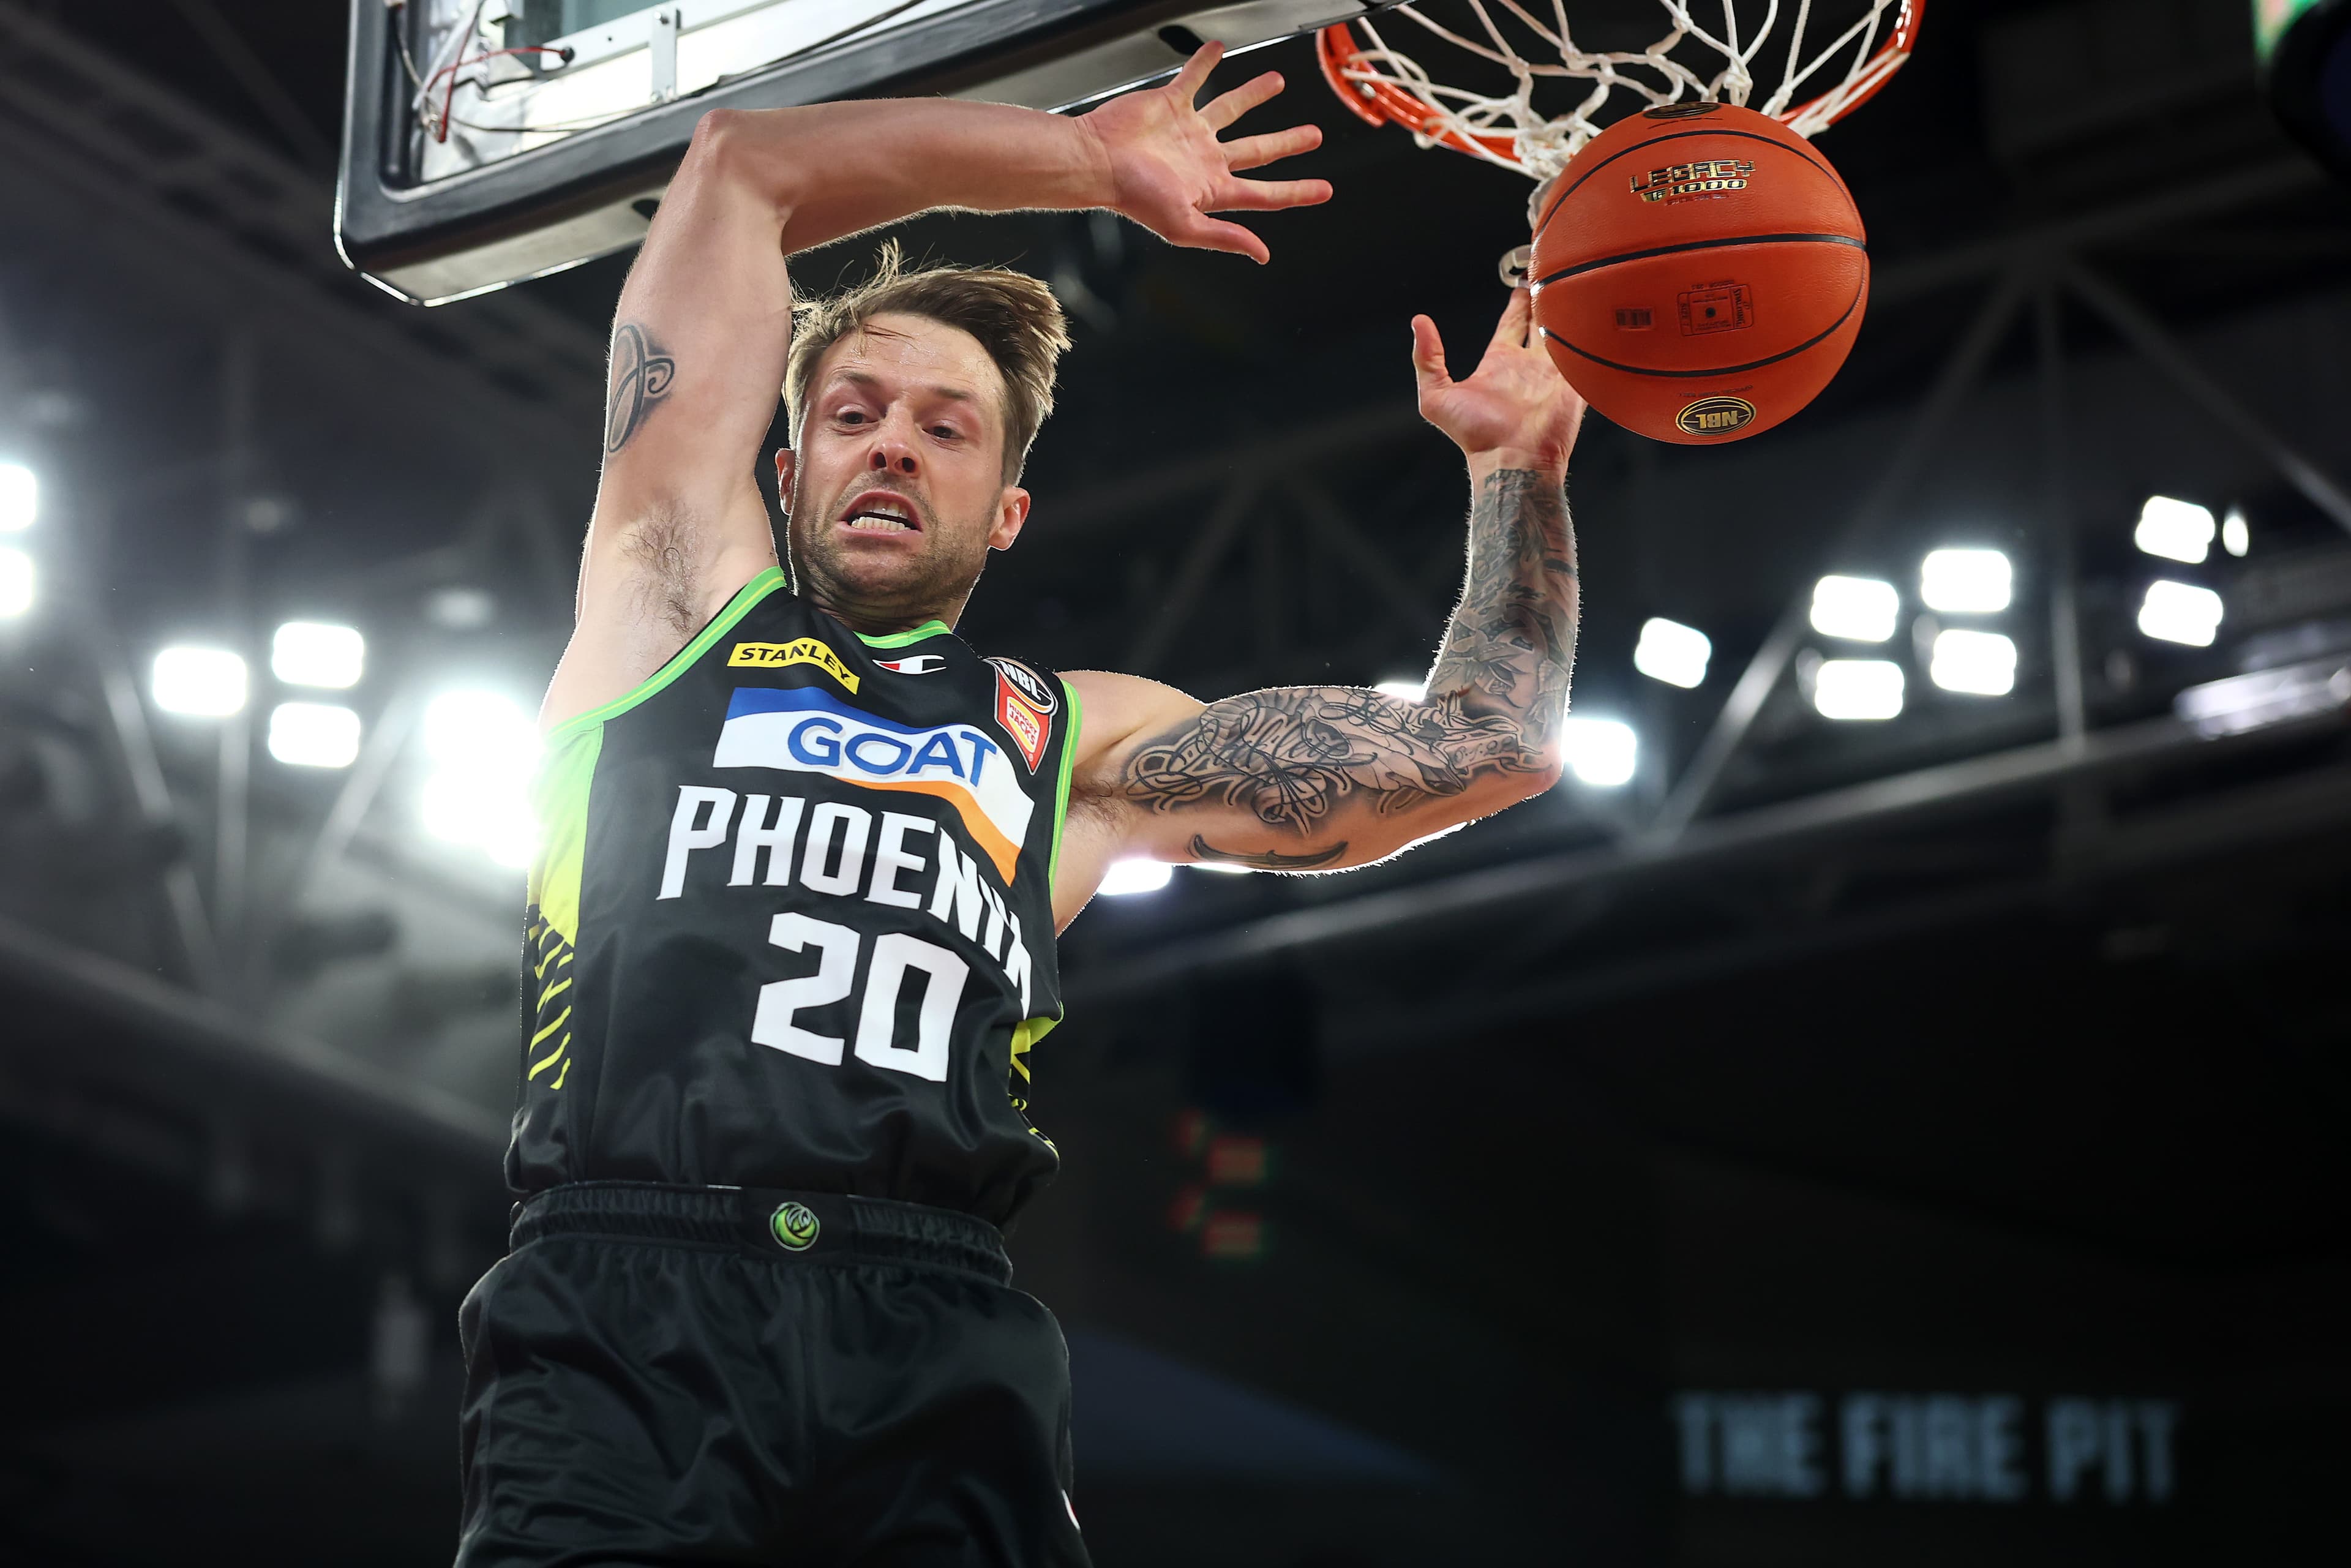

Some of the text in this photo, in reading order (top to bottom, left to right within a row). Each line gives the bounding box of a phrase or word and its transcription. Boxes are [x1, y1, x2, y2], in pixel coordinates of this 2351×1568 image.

[1629, 160, 1756, 193] LEGACY
[1669, 179, 1748, 197] 1000
[1695, 410, 1738, 429] NBL
[739, 644, 851, 680] STANLEY
[997, 659, 1042, 702] NBL
[1009, 702, 1038, 735] HUNGRY
[788, 717, 997, 789] GOAT
[656, 785, 1032, 1021] PHOENIX
[751, 912, 970, 1082] 20
[1674, 1390, 2176, 1500] THE FIRE PIT
